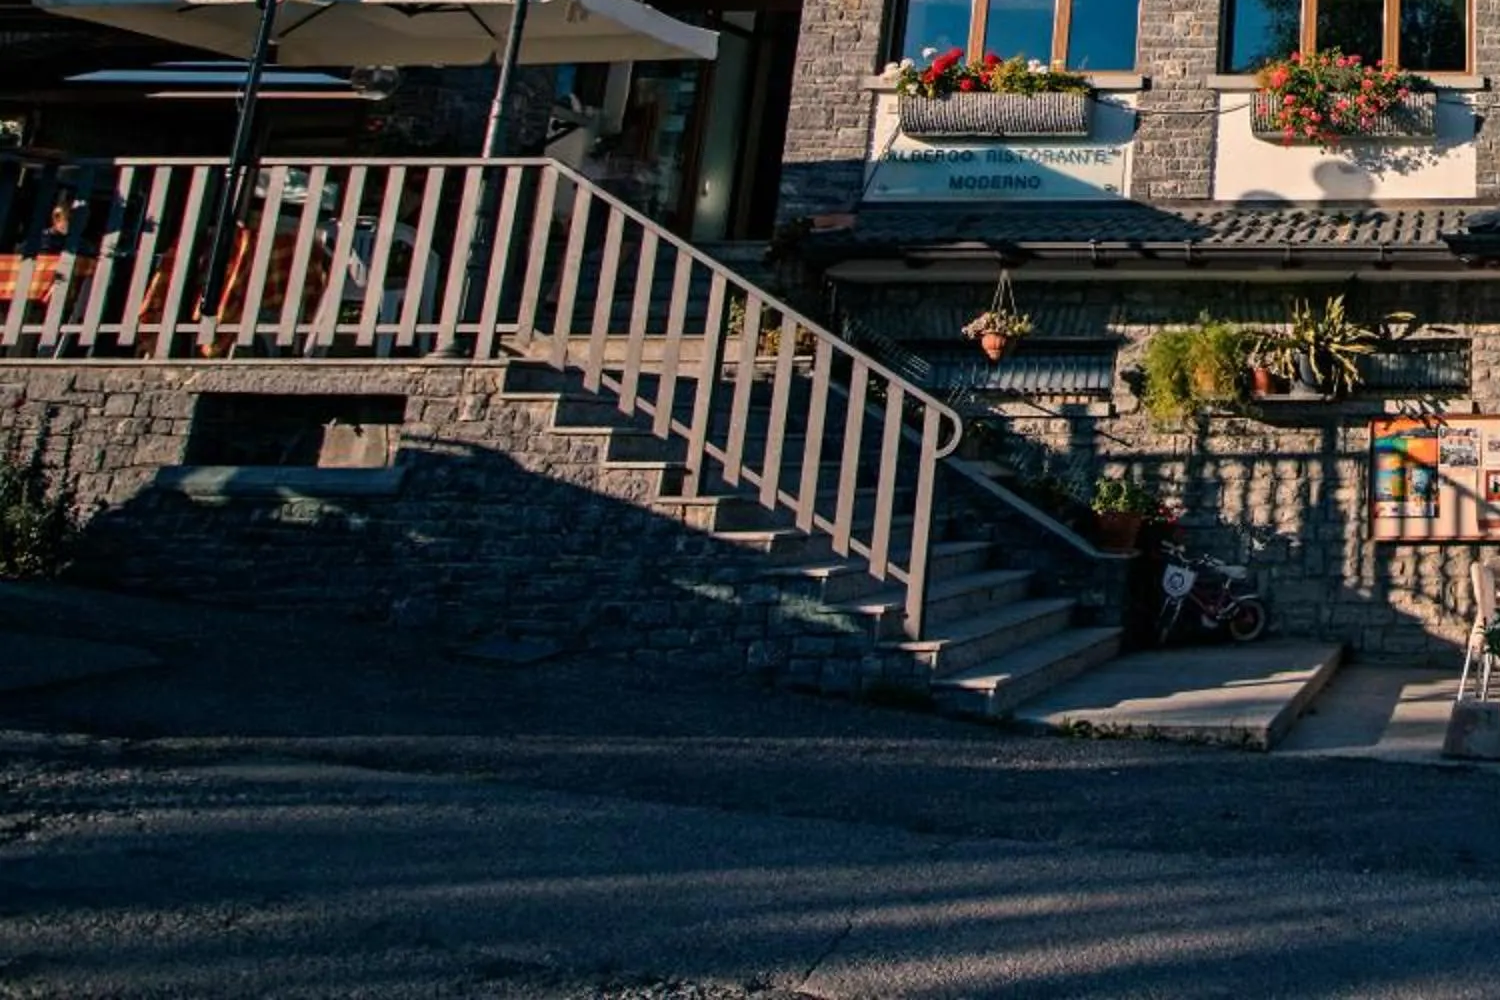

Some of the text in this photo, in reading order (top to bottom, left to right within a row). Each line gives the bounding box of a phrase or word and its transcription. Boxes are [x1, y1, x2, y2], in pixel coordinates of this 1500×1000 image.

[886, 148, 1110, 164] ALBERGO RISTORANTE
[949, 174, 1042, 190] MODERNO
